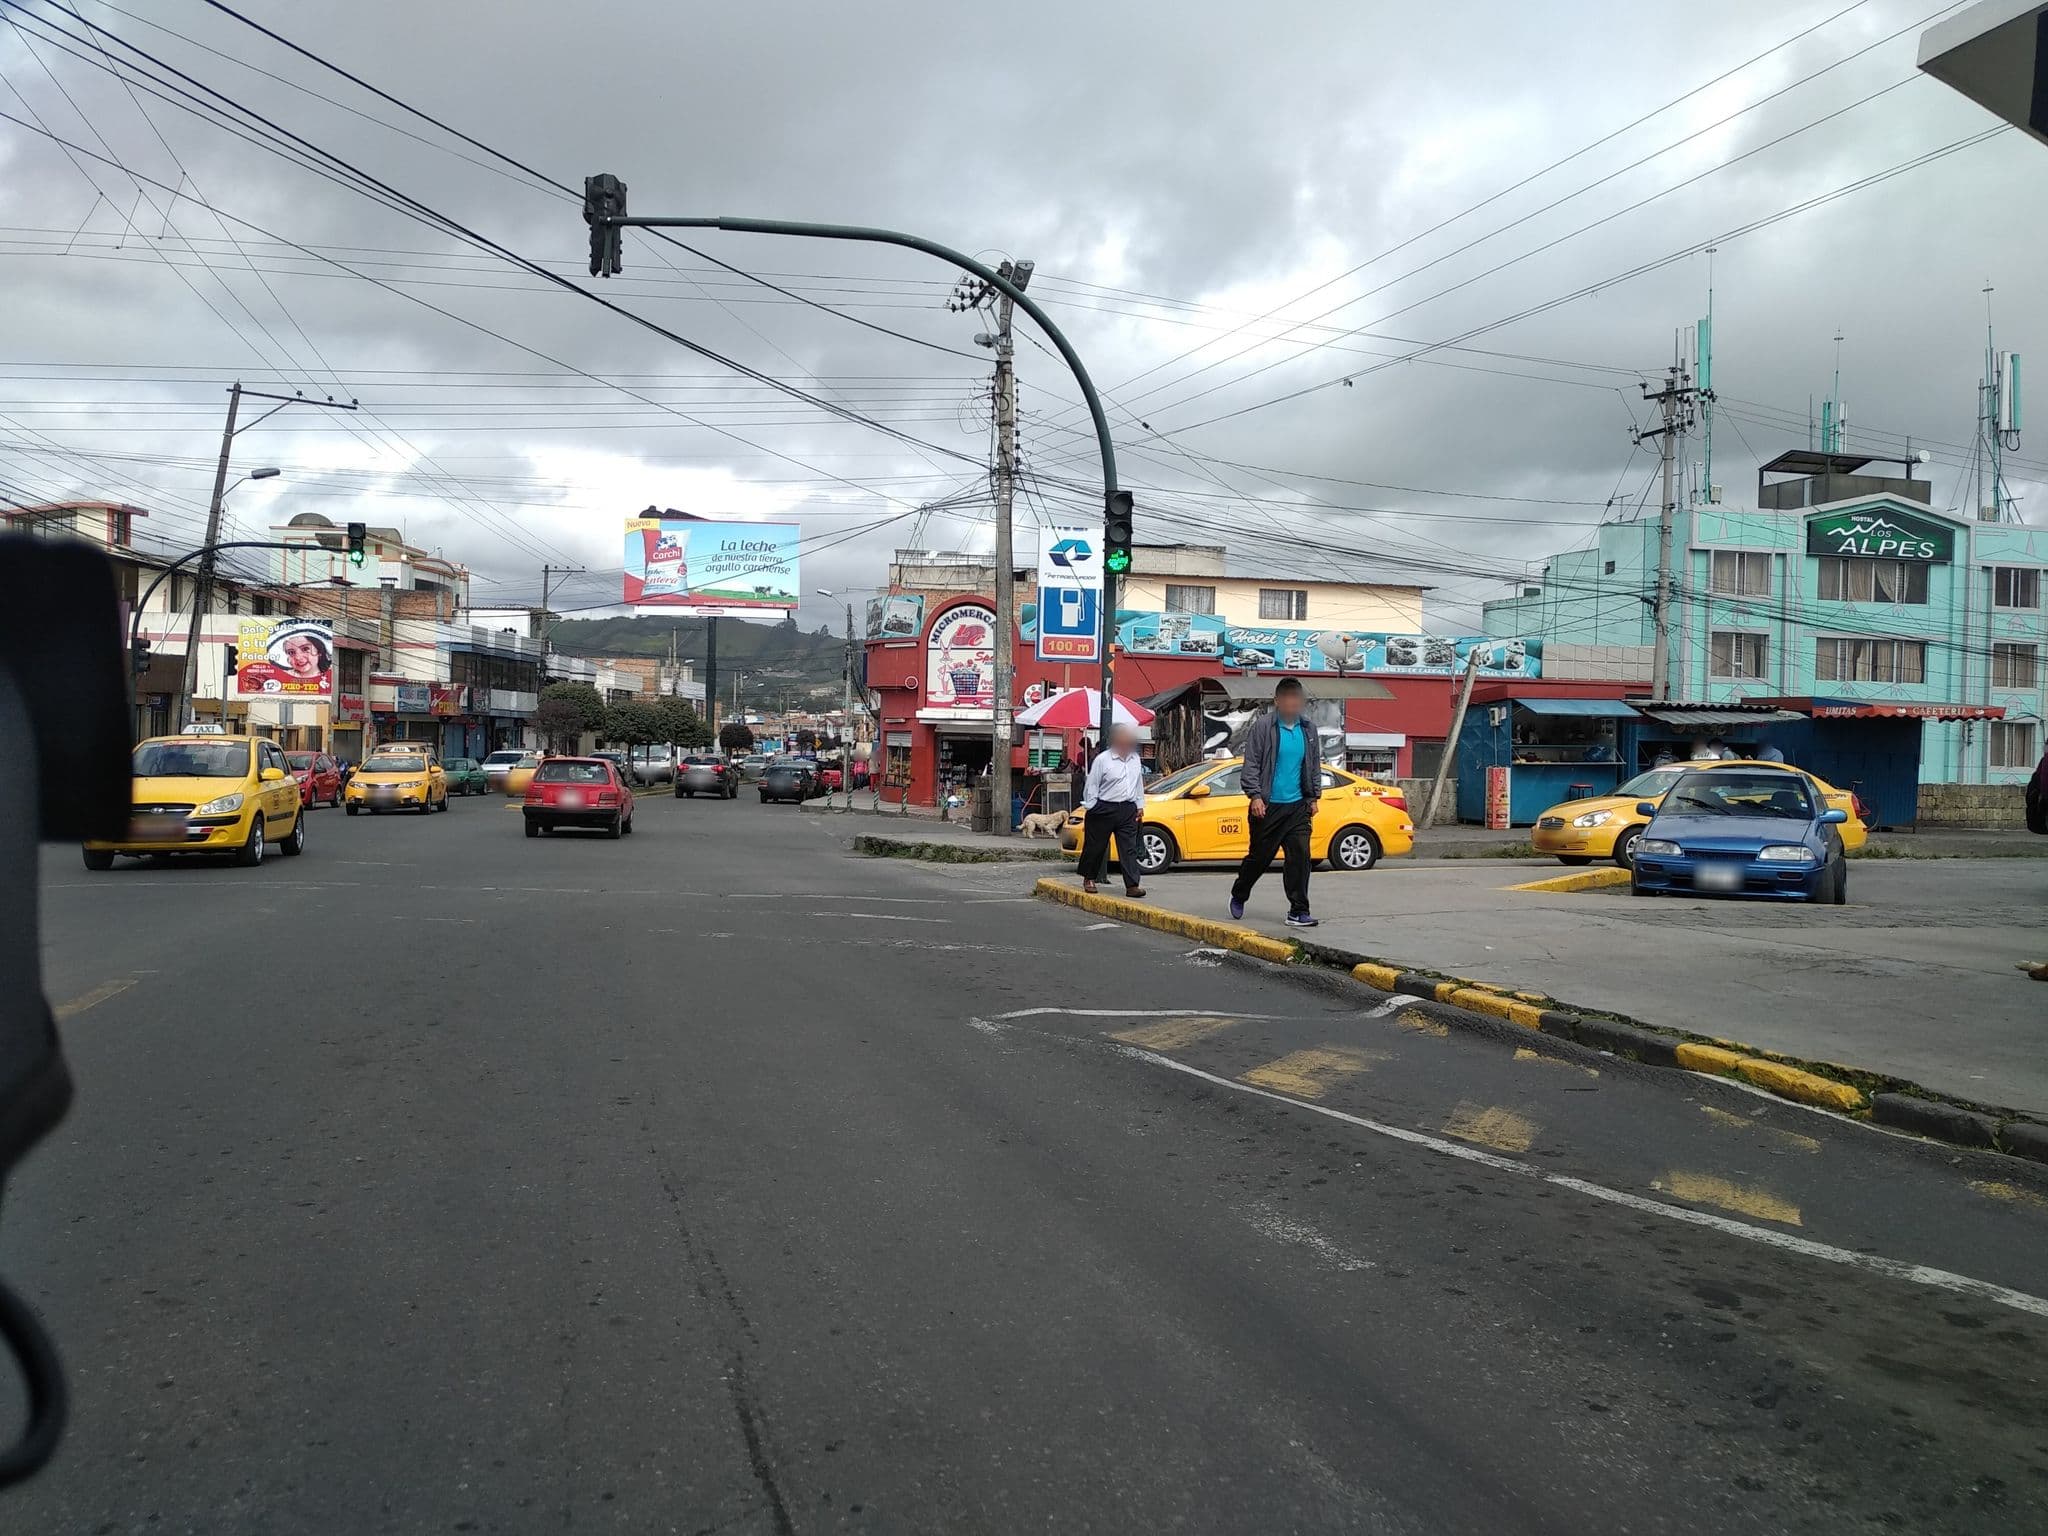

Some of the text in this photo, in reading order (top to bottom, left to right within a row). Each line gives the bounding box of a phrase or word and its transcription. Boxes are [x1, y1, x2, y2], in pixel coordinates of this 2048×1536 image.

[1870, 529, 1892, 537] LOS
[720, 540, 777, 553] La leche
[1837, 537, 1936, 558] ALPES
[652, 549, 681, 560] Carchi
[711, 553, 783, 564] de nuestra tierra
[705, 562, 791, 575] orgullo carchense
[1229, 629, 1279, 645] Hotel
[1284, 631, 1297, 645] &
[254, 638, 266, 648] tu
[1048, 640, 1090, 653] 100 m
[1825, 706, 1968, 716] UMITAS CAFETERIA
[192, 725, 216, 733] TAXI
[1221, 824, 1239, 834] 002
